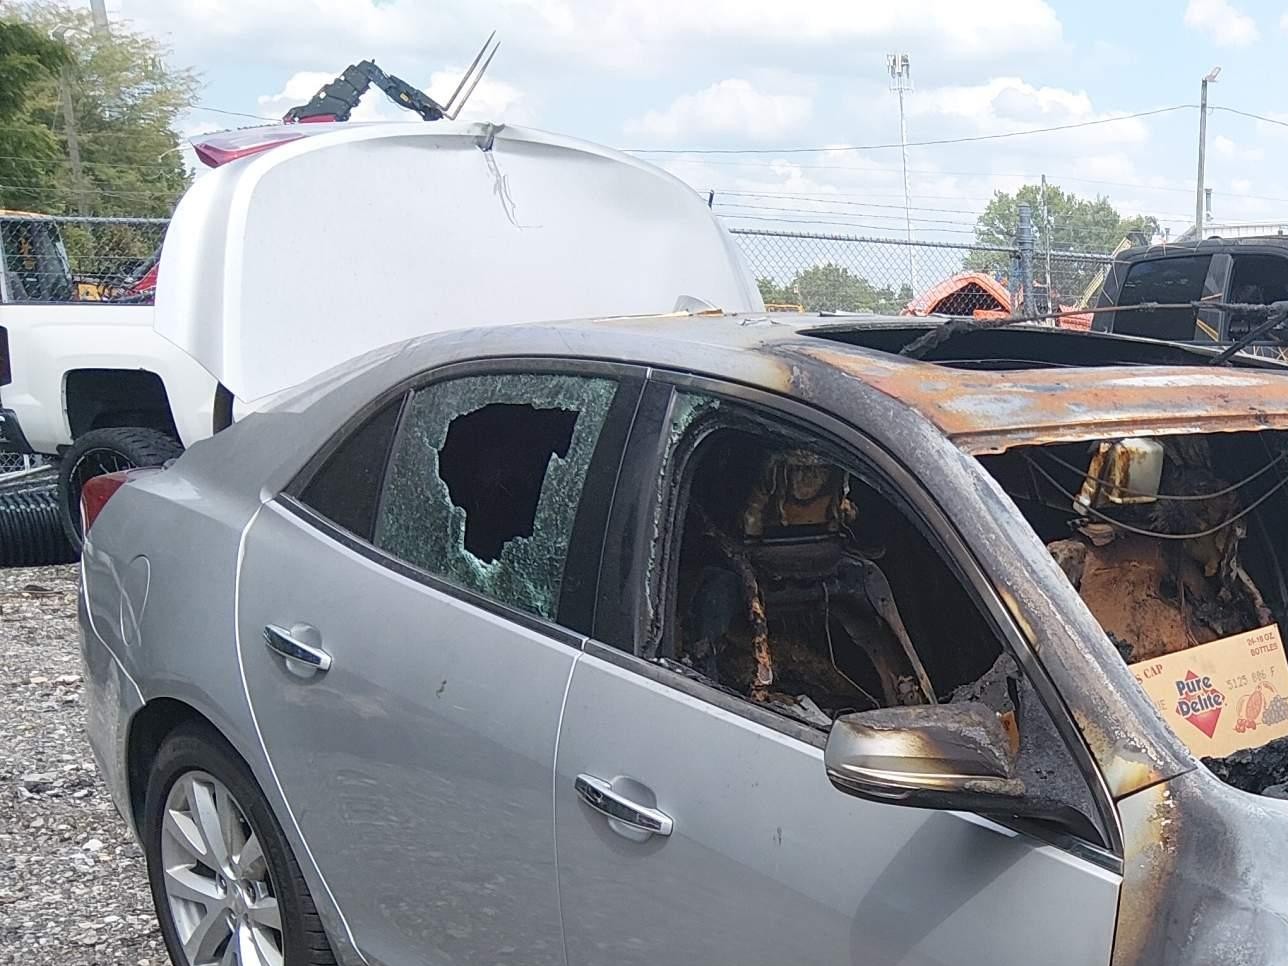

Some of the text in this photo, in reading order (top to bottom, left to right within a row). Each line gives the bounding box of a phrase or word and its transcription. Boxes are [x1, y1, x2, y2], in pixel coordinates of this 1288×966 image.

[1250, 642, 1278, 656] BOTTLES
[1144, 664, 1163, 679] CAP
[1176, 676, 1212, 696] Pure
[1226, 674, 1248, 690] 5125
[1178, 692, 1223, 717] Delite
